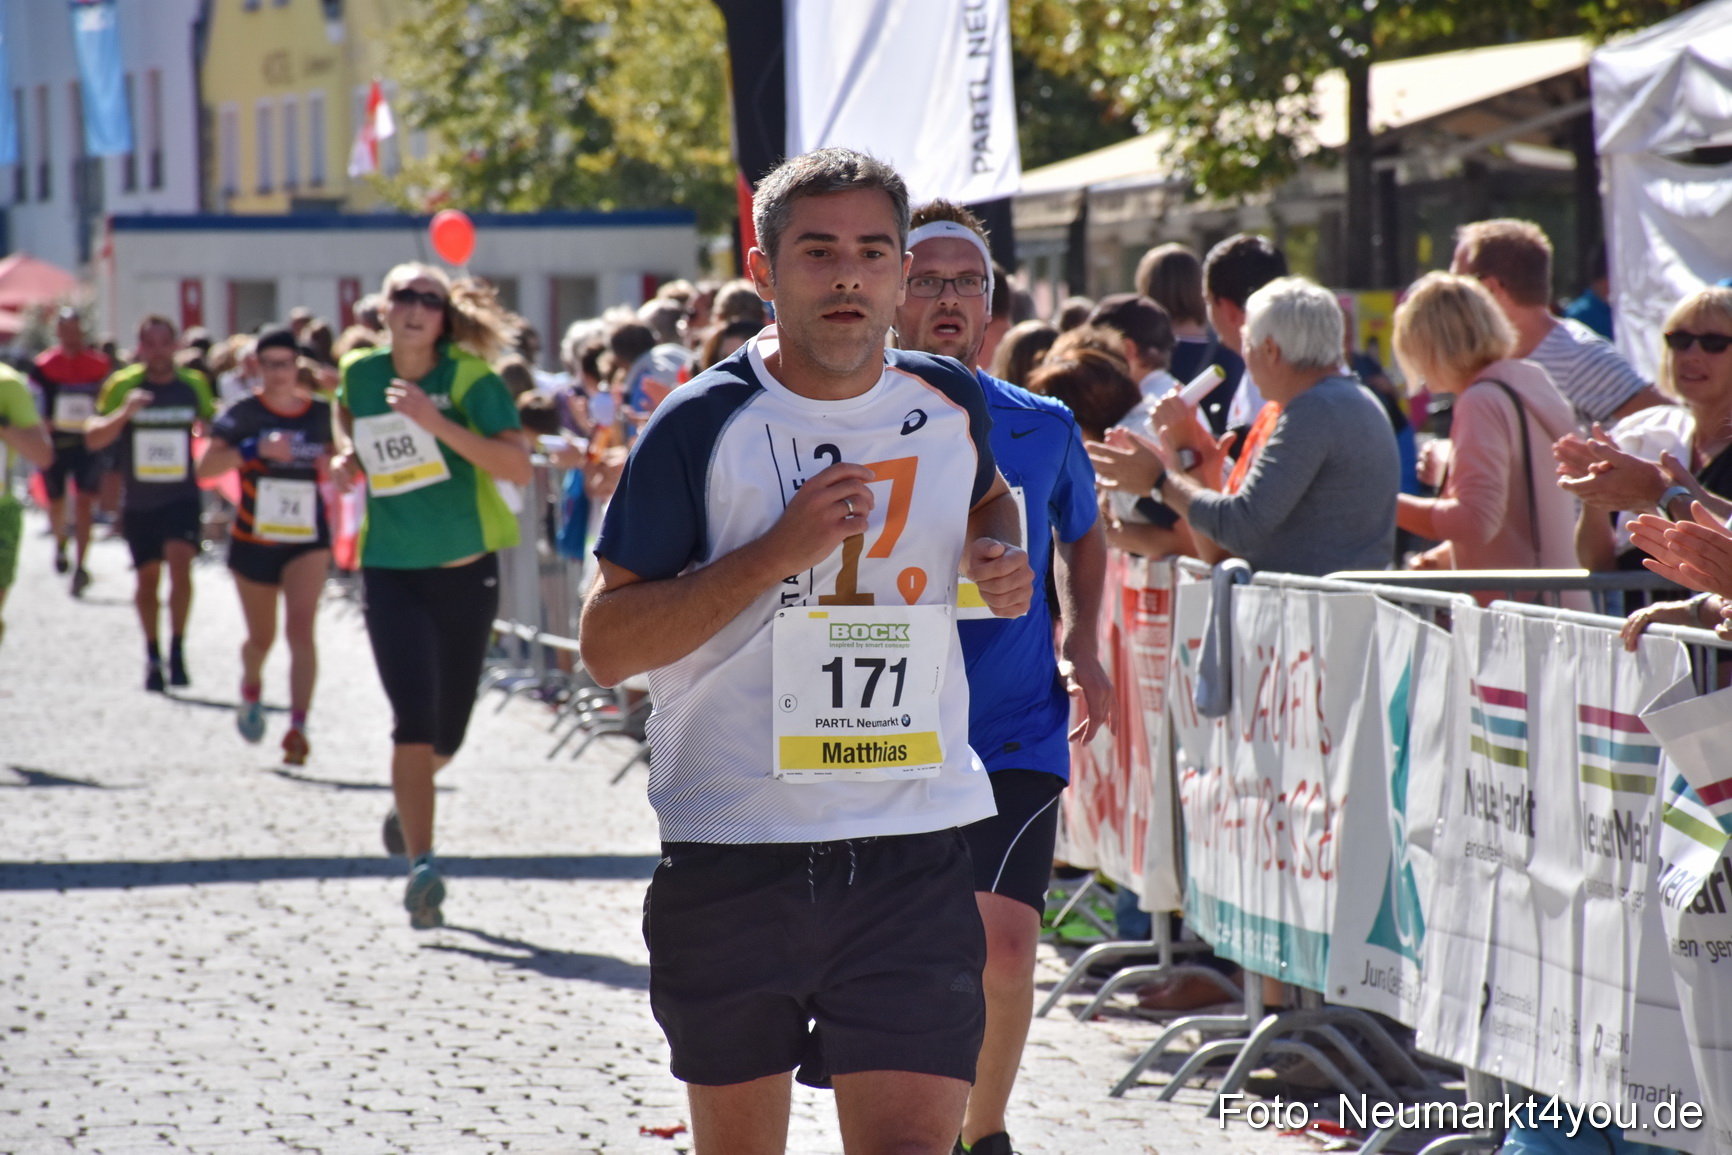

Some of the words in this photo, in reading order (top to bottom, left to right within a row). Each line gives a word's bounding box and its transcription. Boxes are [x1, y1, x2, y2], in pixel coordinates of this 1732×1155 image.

[968, 68, 995, 176] PARTL
[373, 435, 417, 463] 168
[829, 623, 911, 641] BOCK
[829, 641, 855, 649] inspired
[856, 641, 864, 650] by
[821, 656, 908, 709] 171
[784, 698, 792, 709] C
[815, 718, 854, 729] PARTL
[856, 716, 900, 729] Neumarkt
[821, 741, 908, 764] Matthias
